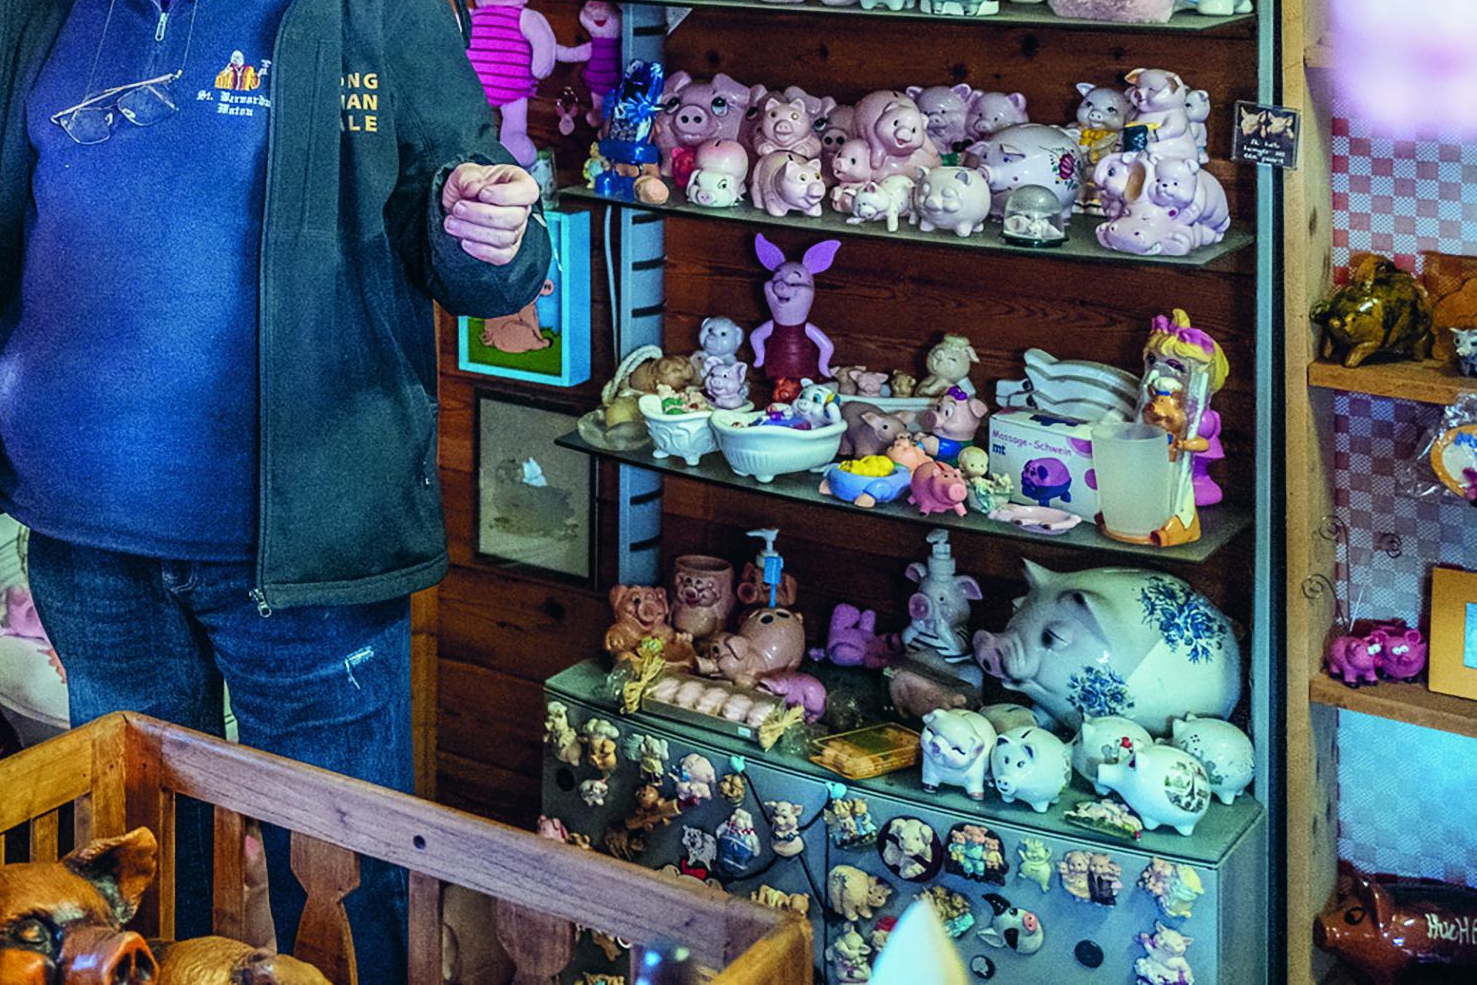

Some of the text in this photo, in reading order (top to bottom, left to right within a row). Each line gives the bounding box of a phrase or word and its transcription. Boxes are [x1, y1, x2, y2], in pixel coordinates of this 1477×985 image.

[341, 72, 378, 90] NG
[220, 91, 271, 107] Bernardu
[340, 94, 378, 111] AN
[340, 115, 378, 132] LE
[992, 443, 1006, 455] mt
